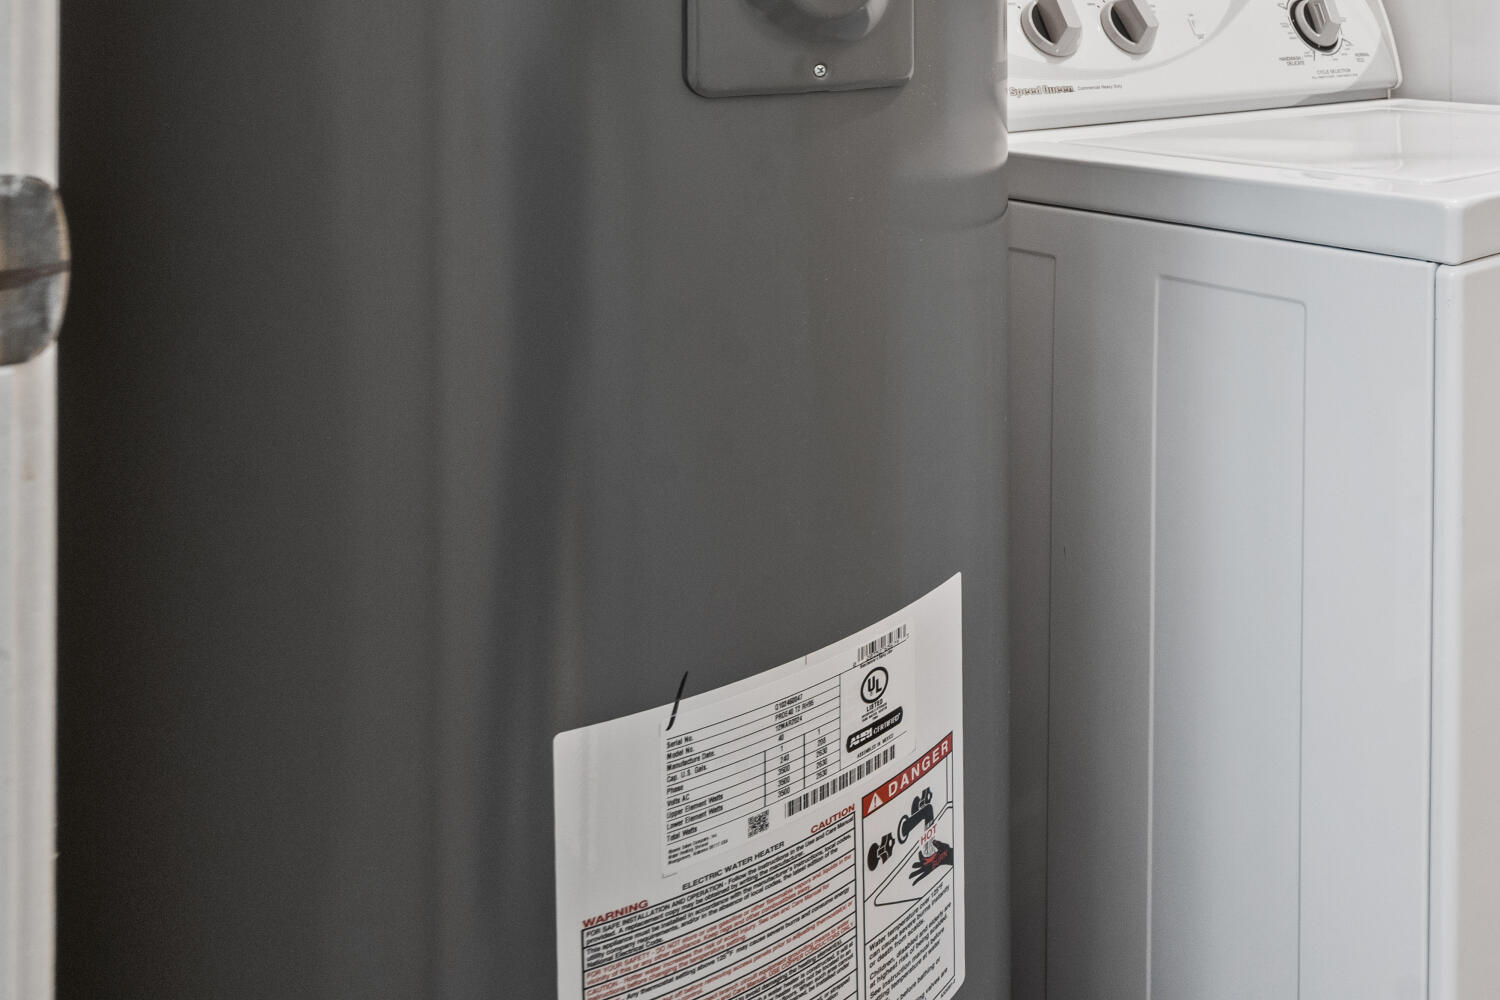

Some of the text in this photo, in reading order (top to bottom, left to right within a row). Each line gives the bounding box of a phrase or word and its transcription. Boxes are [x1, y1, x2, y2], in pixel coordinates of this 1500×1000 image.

[1008, 84, 1042, 99] Speed
[867, 675, 883, 693] UL
[866, 698, 883, 712] LISTED
[873, 714, 900, 735] CERTIFIED
[666, 738, 683, 748] Serial
[666, 749, 684, 760] Model
[666, 755, 700, 771] Manufacture
[780, 754, 790, 763] 240
[778, 765, 790, 775] 3500
[888, 740, 948, 797] DANGER
[667, 784, 684, 794] Phase
[778, 776, 790, 787] 3500
[778, 787, 790, 797] 3500
[667, 797, 681, 807] Volts
[667, 794, 723, 819] Upper Element Watts
[667, 805, 723, 830] Lower Element Watts
[811, 804, 856, 834] CAUTION
[667, 826, 698, 842] Total Watts
[920, 823, 938, 846] HOT
[603, 816, 854, 931] SAFE INSTALLATION AND OPERATION Follow Manual
[682, 841, 784, 890] ELECTRIC WATER HEATER
[582, 899, 649, 927] WARNING
[606, 943, 635, 955] company
[681, 916, 700, 927] and/or
[719, 897, 743, 910] absence
[751, 887, 764, 896] local
[807, 856, 824, 867] edition
[625, 914, 664, 931] replacement
[704, 887, 730, 900] obtained
[602, 936, 633, 948] appliance
[634, 929, 650, 938] must
[662, 915, 687, 927] installed
[694, 897, 729, 914] accordance
[730, 891, 742, 899] with
[881, 884, 949, 950] cause severe burns instantly
[869, 908, 919, 950] Water temperature
[641, 977, 674, 993] thermostat
[675, 968, 696, 980] setting
[697, 958, 715, 970] above
[749, 936, 766, 946] cause
[767, 926, 784, 937] severe
[785, 917, 800, 927] burns
[811, 898, 833, 912] consume
[834, 888, 850, 899] energy
[897, 936, 918, 957] disabled
[587, 955, 614, 966] National
[615, 944, 644, 957] Electrical
[624, 952, 650, 965] SAFETY
[798, 955, 817, 969] heating
[822, 957, 840, 970] located
[877, 947, 893, 961] death
[882, 927, 944, 988] instruction manual before
[784, 976, 799, 988] heater
[799, 954, 853, 991] When such cannot
[816, 962, 849, 987] installed under
[877, 963, 897, 984] highest
[891, 960, 922, 990] temperature
[587, 981, 618, 995] CAUTION
